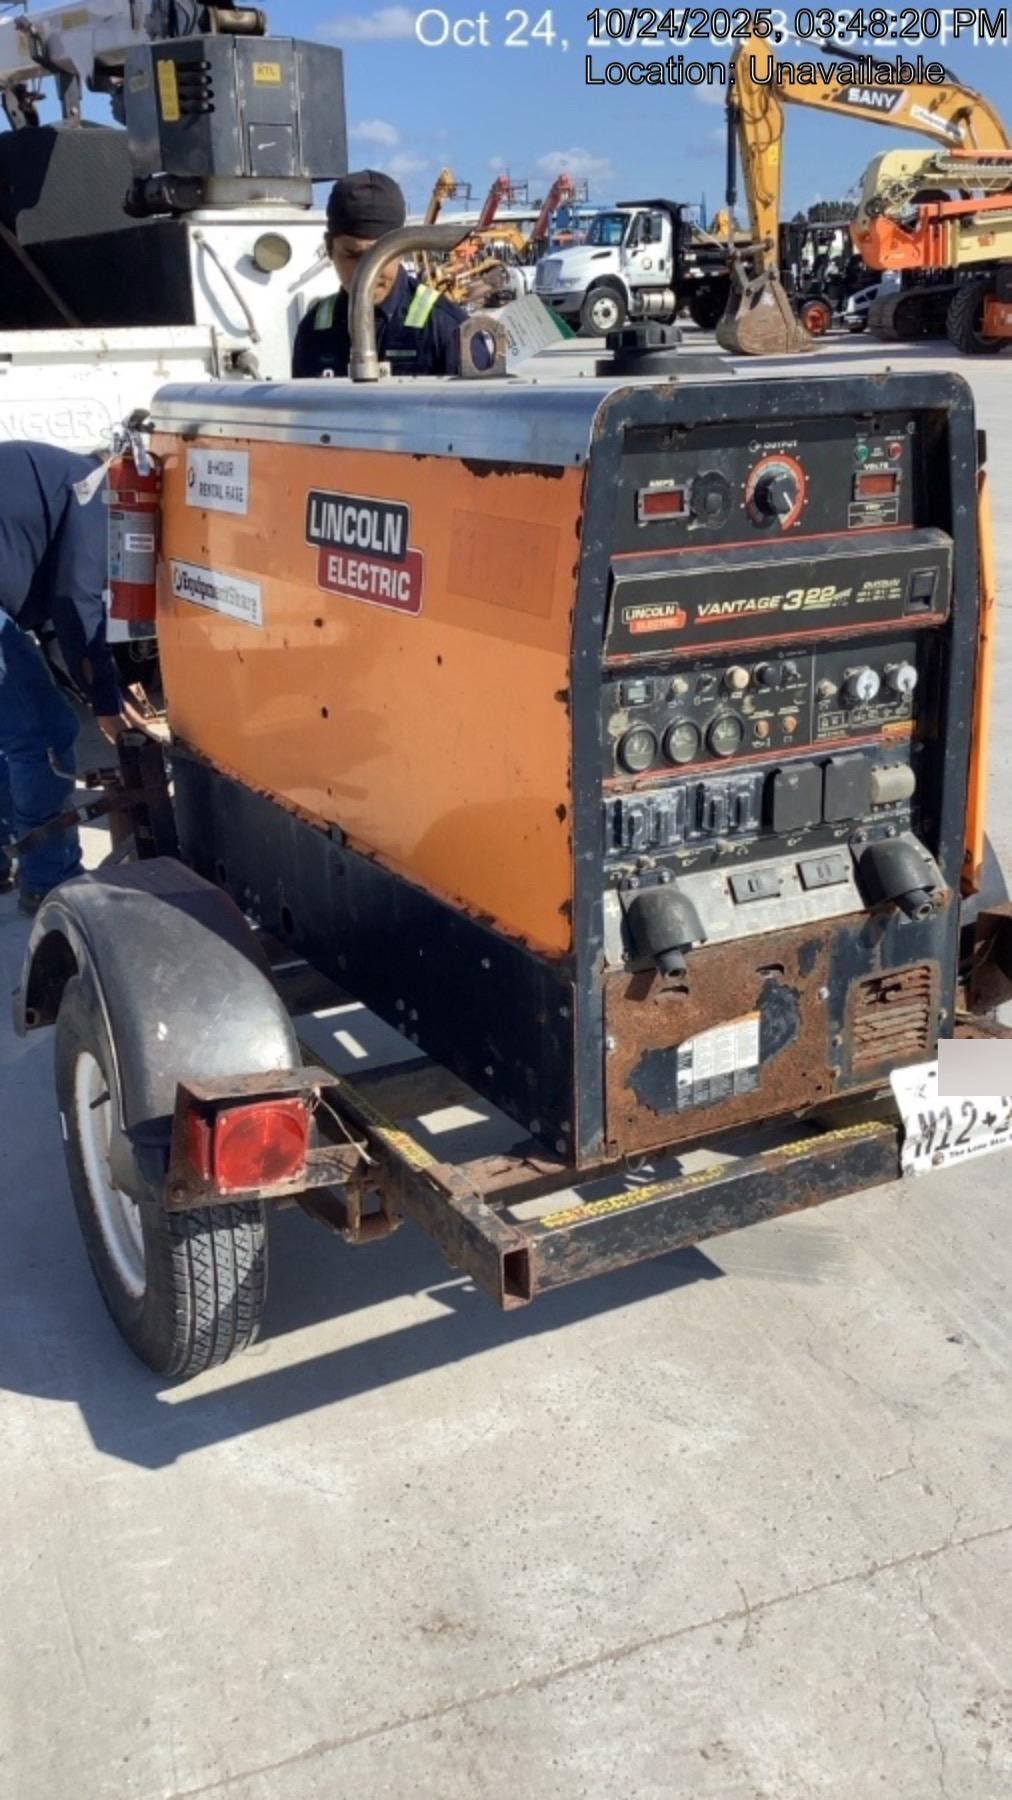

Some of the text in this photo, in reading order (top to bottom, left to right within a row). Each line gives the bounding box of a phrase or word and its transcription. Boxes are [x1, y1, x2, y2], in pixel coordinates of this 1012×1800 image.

[848, 87, 896, 108] SANY
[309, 500, 402, 554] LINCOLN
[327, 555, 410, 602] ELECTRIC
[625, 605, 675, 620] LINCOLN
[697, 595, 783, 617] VANTAGE
[782, 585, 837, 611] 322
